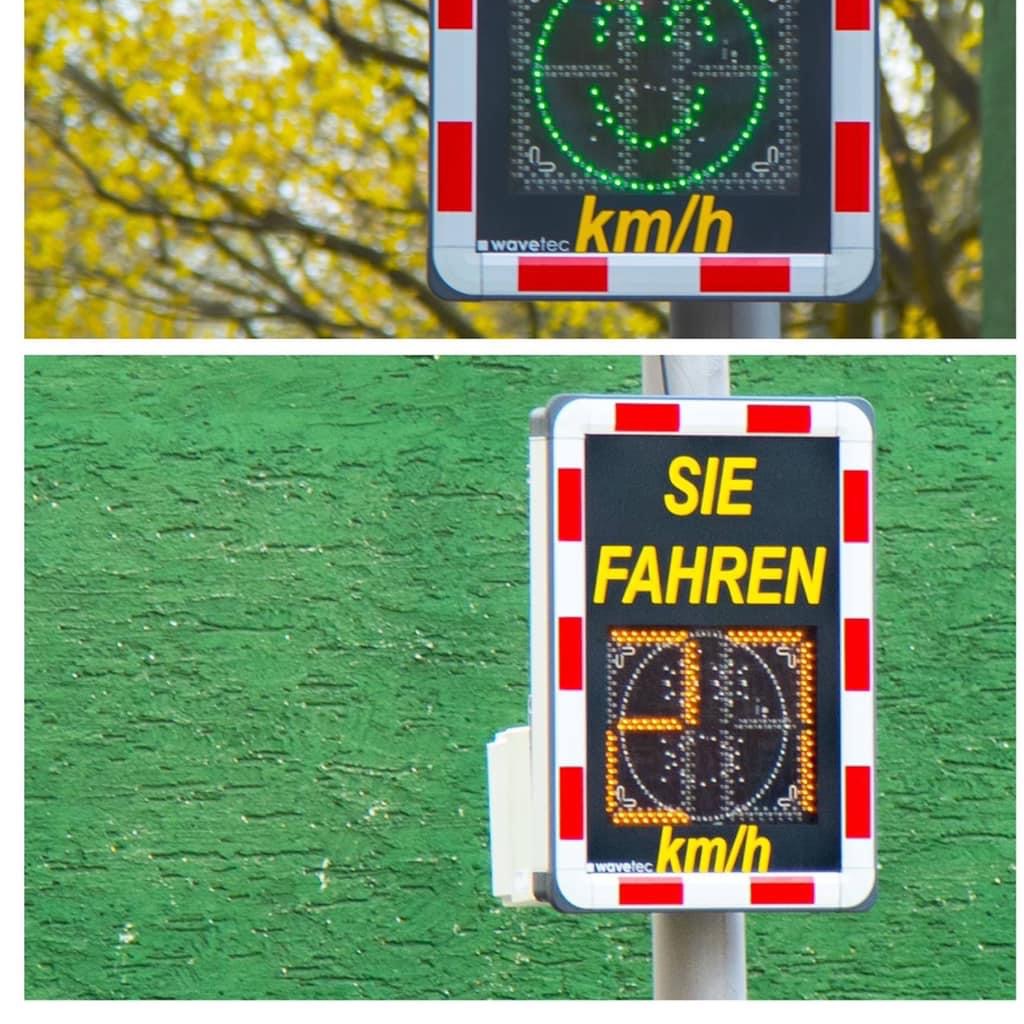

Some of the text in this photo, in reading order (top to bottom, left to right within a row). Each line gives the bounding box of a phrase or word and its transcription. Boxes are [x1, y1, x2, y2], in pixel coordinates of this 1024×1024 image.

[490, 237, 570, 252] wavetec
[575, 194, 733, 252] km/h
[663, 455, 758, 517] SIE
[592, 544, 828, 605] FAHREN
[606, 628, 816, 826] 27
[595, 860, 654, 873] wavetec
[655, 825, 772, 873] km/h
